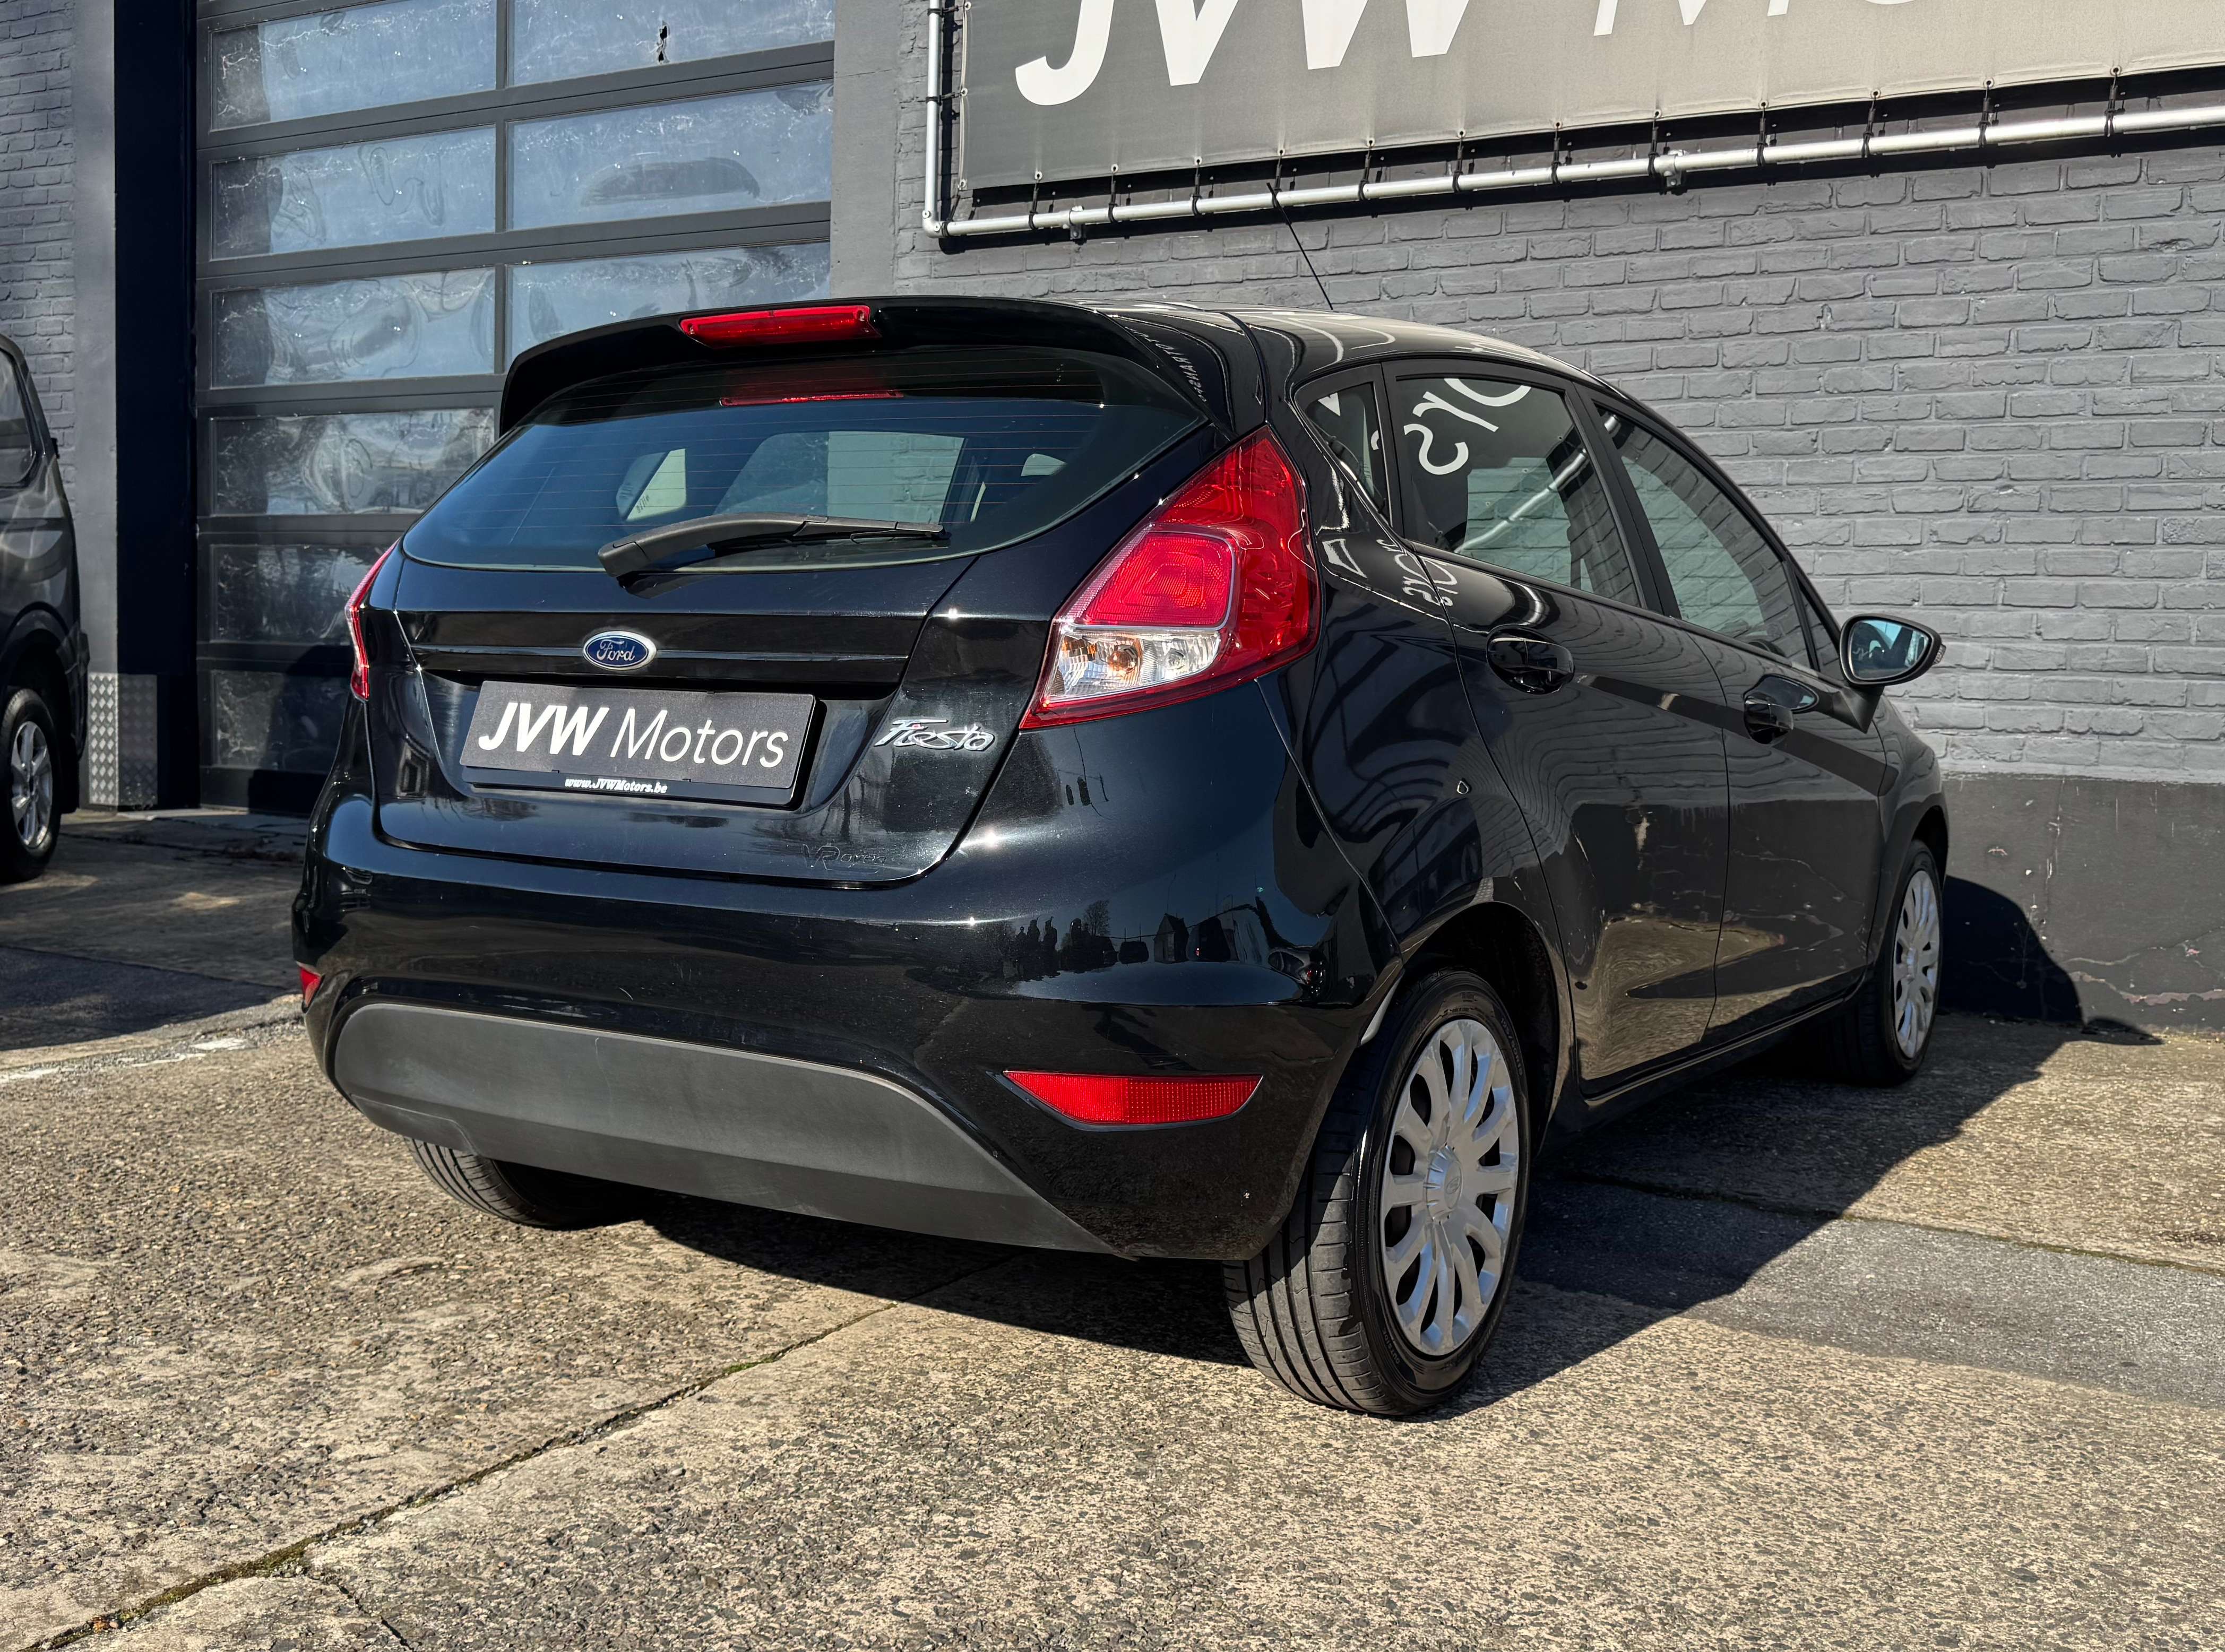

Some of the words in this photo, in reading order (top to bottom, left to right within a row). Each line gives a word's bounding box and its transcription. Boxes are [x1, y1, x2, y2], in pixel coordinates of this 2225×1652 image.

[596, 639, 635, 661] Ford
[478, 702, 610, 756] JVW
[610, 708, 788, 768] Motors
[874, 719, 995, 751] Fiesta
[564, 778, 668, 794] www.JVWMotors.be
